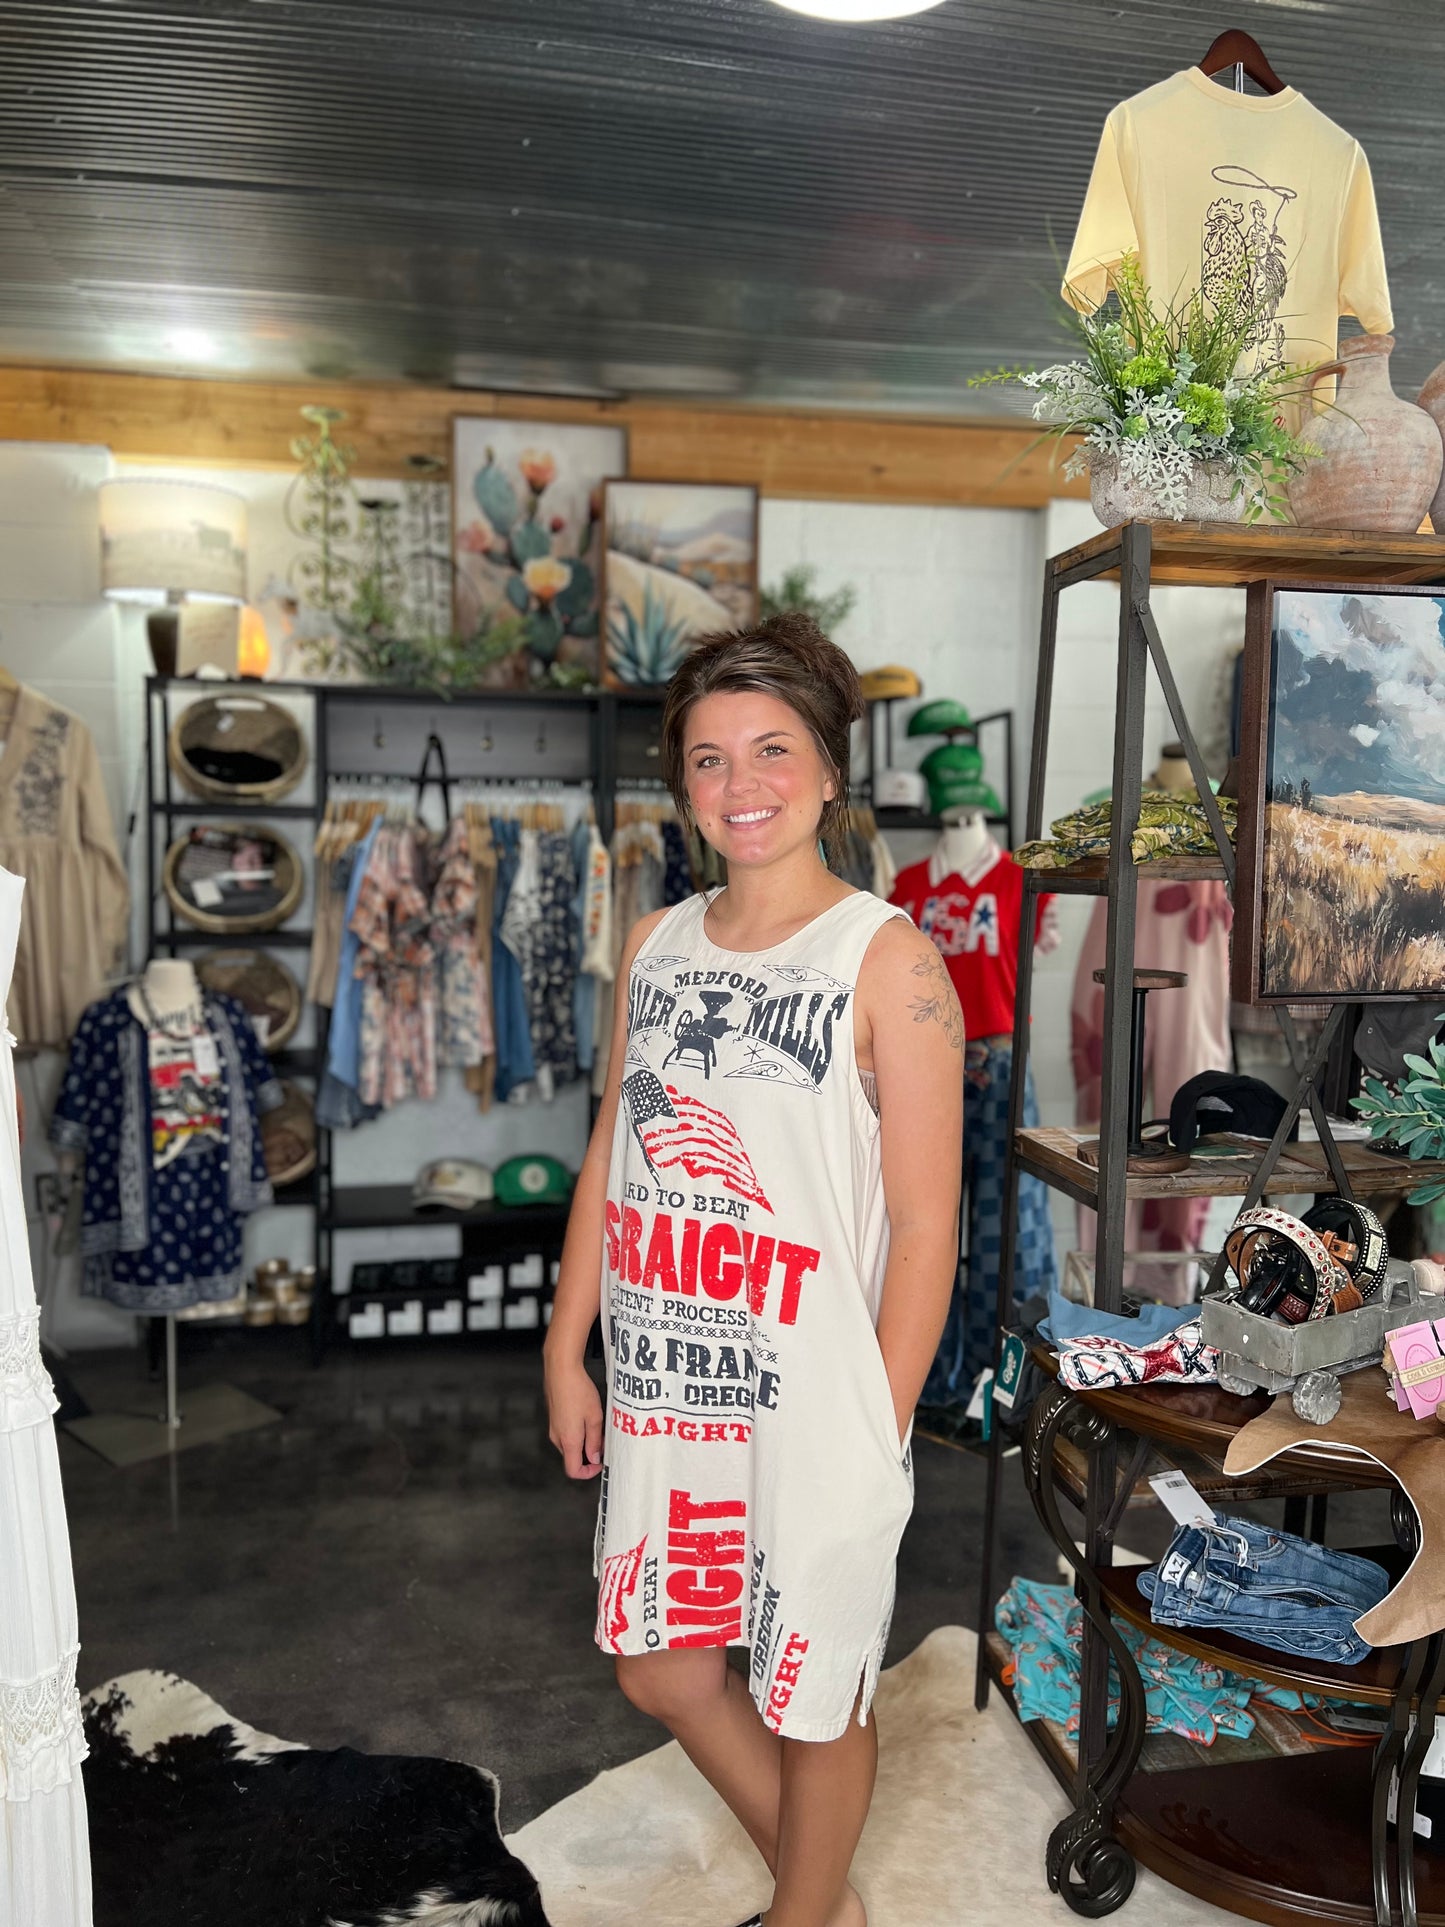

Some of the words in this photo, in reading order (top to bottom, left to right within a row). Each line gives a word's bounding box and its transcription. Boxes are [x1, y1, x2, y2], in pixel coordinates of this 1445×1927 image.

[674, 970, 769, 1000] MEDFORD
[744, 992, 850, 1086] MILLS
[656, 1189, 685, 1209] TO
[693, 1193, 749, 1221] BEAT
[662, 1299, 748, 1327] PROCESS
[635, 1334, 657, 1372] &
[612, 1406, 751, 1443] TRAIGHT
[644, 1557, 658, 1623] BEAT
